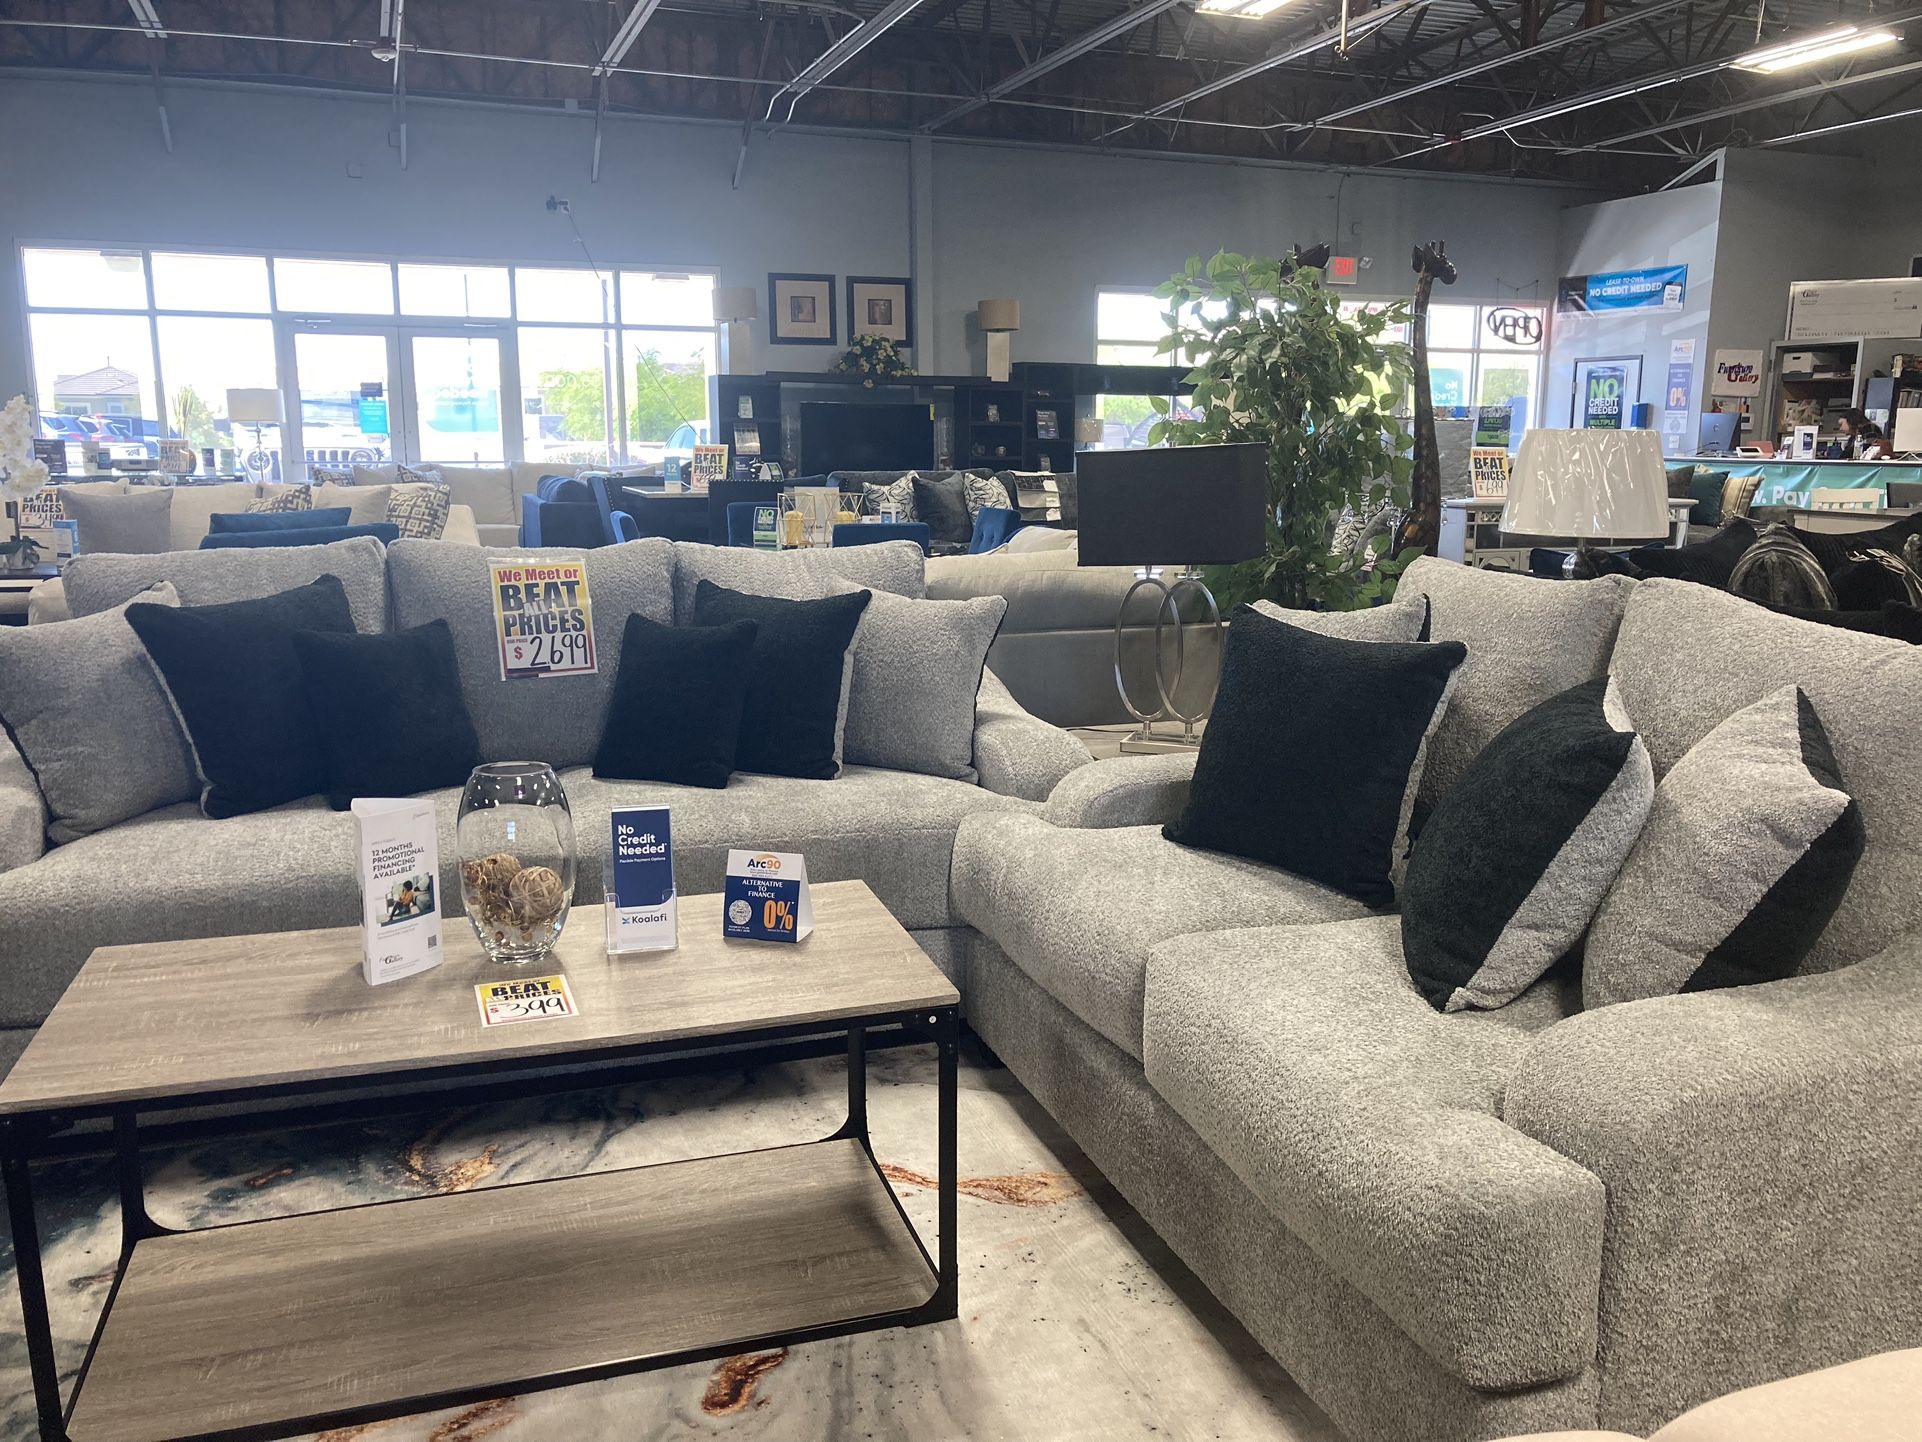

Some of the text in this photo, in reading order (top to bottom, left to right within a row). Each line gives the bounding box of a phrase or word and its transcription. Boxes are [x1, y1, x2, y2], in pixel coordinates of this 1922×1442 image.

[1589, 288, 1600, 297] NO
[1602, 286, 1628, 297] CREDIT
[1630, 282, 1662, 293] NEEDED
[1590, 378, 1619, 400] NO
[1588, 398, 1620, 408] CREDIT
[1587, 406, 1619, 415] NEEDED
[694, 453, 724, 465] BEAT
[1473, 457, 1504, 470] BEAT
[666, 464, 677, 473] 12
[694, 465, 724, 474] PRICES
[1475, 470, 1506, 480] PRICES
[1486, 480, 1504, 495] 699
[1773, 485, 1810, 509] Pay
[22, 503, 62, 513] PRICES
[758, 509, 774, 518] NO
[497, 568, 579, 582] We Meet or
[500, 580, 580, 612] BEAT
[503, 608, 586, 637] PRICES
[513, 645, 523, 660] $
[617, 824, 635, 835] No
[618, 833, 656, 845] Credit
[371, 849, 380, 857] 12
[381, 842, 413, 855] MONTHS
[372, 846, 425, 865] PROMOTIONAL
[373, 856, 416, 872] FINANCING
[747, 858, 782, 870] Arc90
[741, 879, 784, 888] ALTERNATIVE
[748, 890, 776, 899] FINANCE
[631, 913, 668, 924] Koalafi
[491, 980, 551, 997] BEAT
[503, 989, 562, 1001] PRICES
[500, 997, 566, 1019] 399
